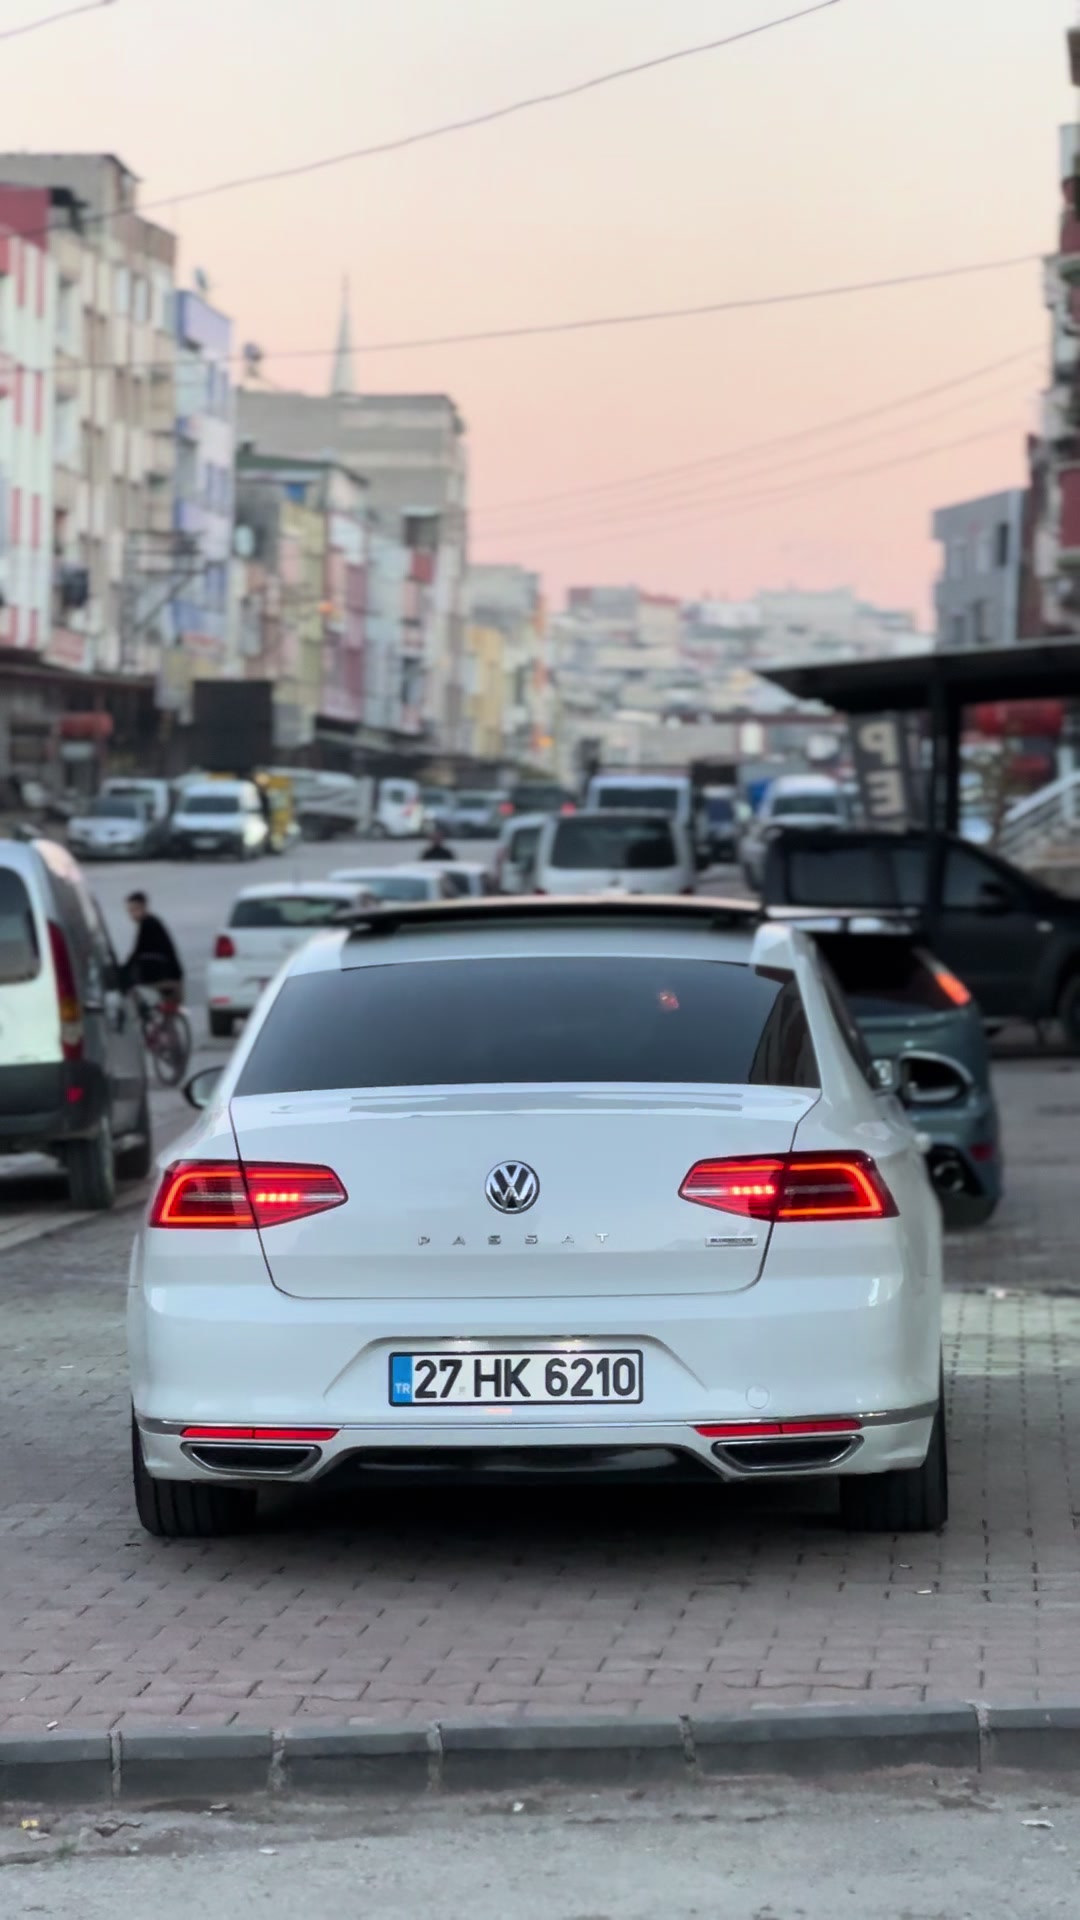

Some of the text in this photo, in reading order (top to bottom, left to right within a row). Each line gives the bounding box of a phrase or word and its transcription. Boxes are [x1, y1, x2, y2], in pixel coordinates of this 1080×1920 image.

[418, 1233, 608, 1246] PASSAT
[414, 1357, 636, 1398] 27 HK 6210
[394, 1382, 411, 1394] TR
